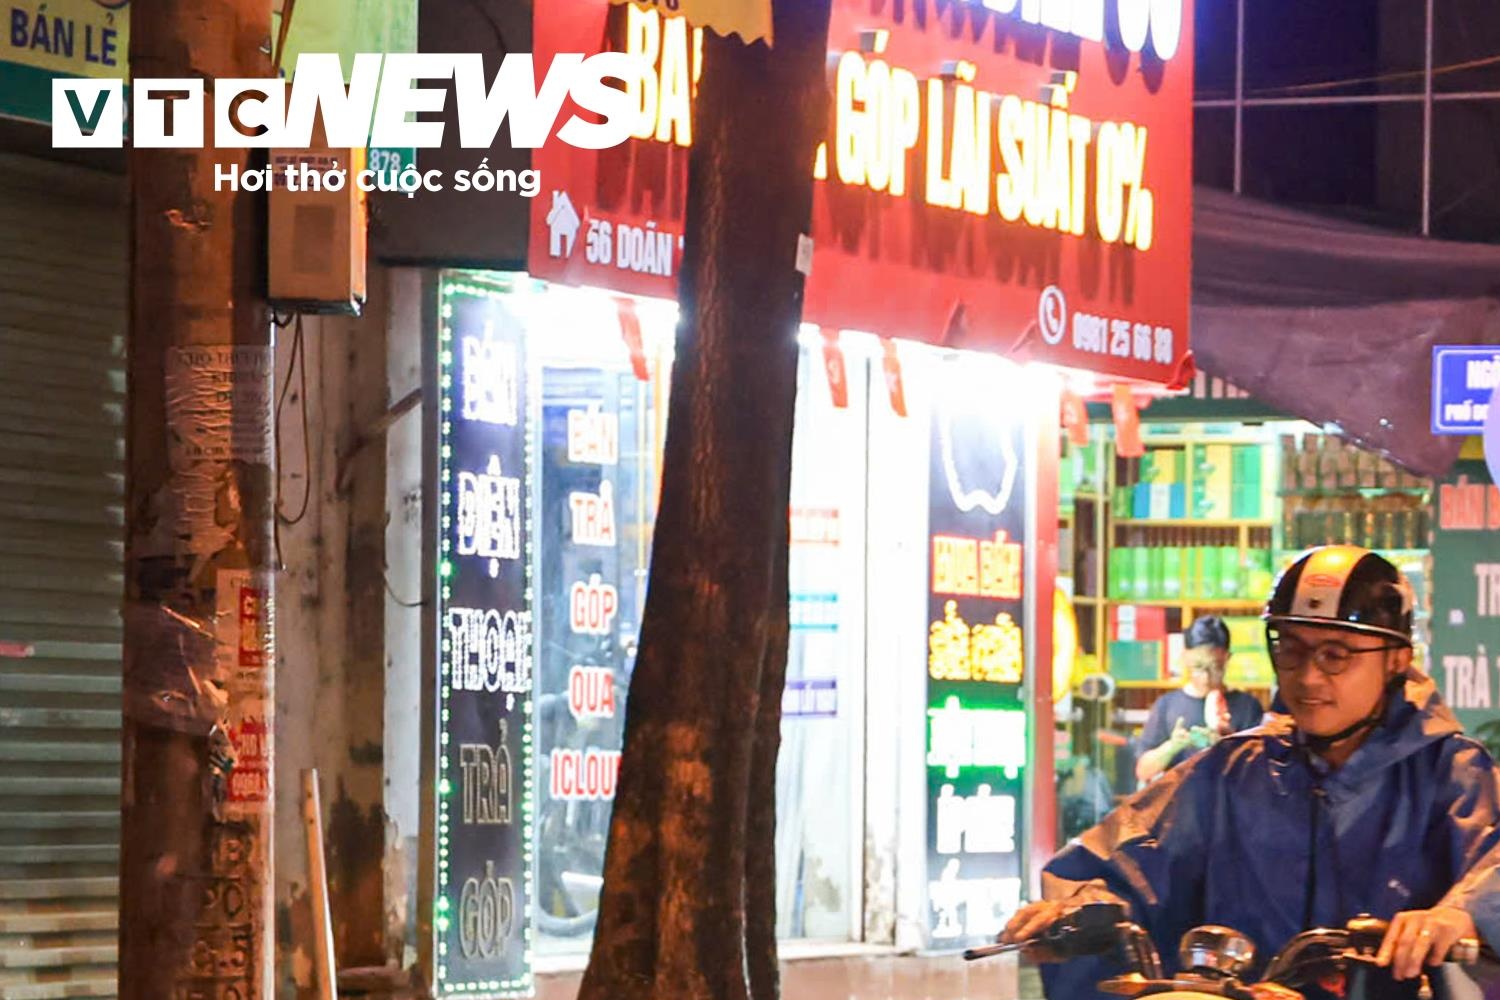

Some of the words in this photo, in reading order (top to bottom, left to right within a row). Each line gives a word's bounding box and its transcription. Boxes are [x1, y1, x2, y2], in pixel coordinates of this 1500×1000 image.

[11, 3, 75, 58] BÁN
[84, 12, 118, 67] LẺ
[836, 30, 920, 196] GÓP
[926, 61, 991, 216] LÃI
[996, 71, 1091, 236] SUẤT
[1096, 121, 1153, 251] 0%
[616, 220, 673, 277] DOÃN
[570, 667, 615, 717] QUA
[1443, 644, 1492, 708] TRÀ
[460, 717, 513, 825] TRẢ
[459, 860, 514, 960] GÓP
